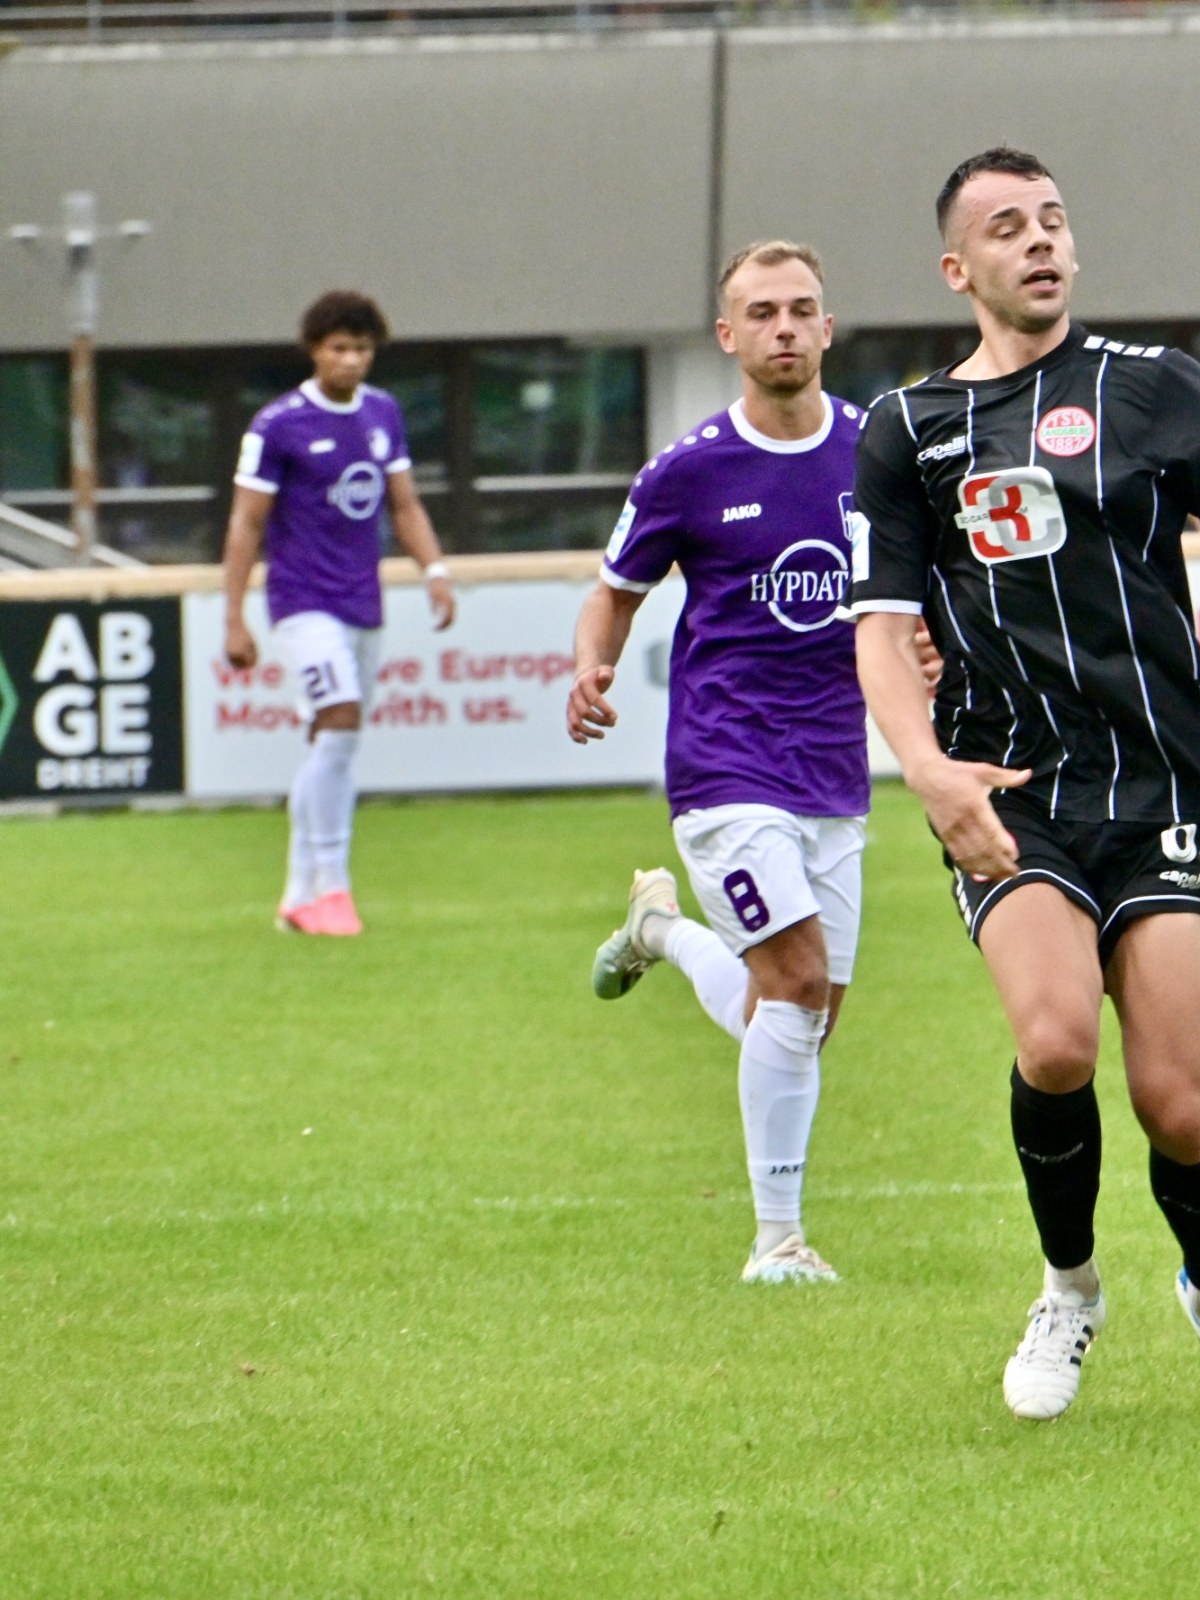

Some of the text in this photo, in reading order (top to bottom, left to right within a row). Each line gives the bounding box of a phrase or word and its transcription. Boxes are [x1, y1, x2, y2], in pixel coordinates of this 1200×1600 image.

[722, 503, 762, 522] JAKO
[750, 570, 849, 602] HYPDAT
[32, 612, 155, 683] AB
[303, 660, 337, 700] 21
[33, 683, 153, 757] GE
[723, 869, 771, 933] 8
